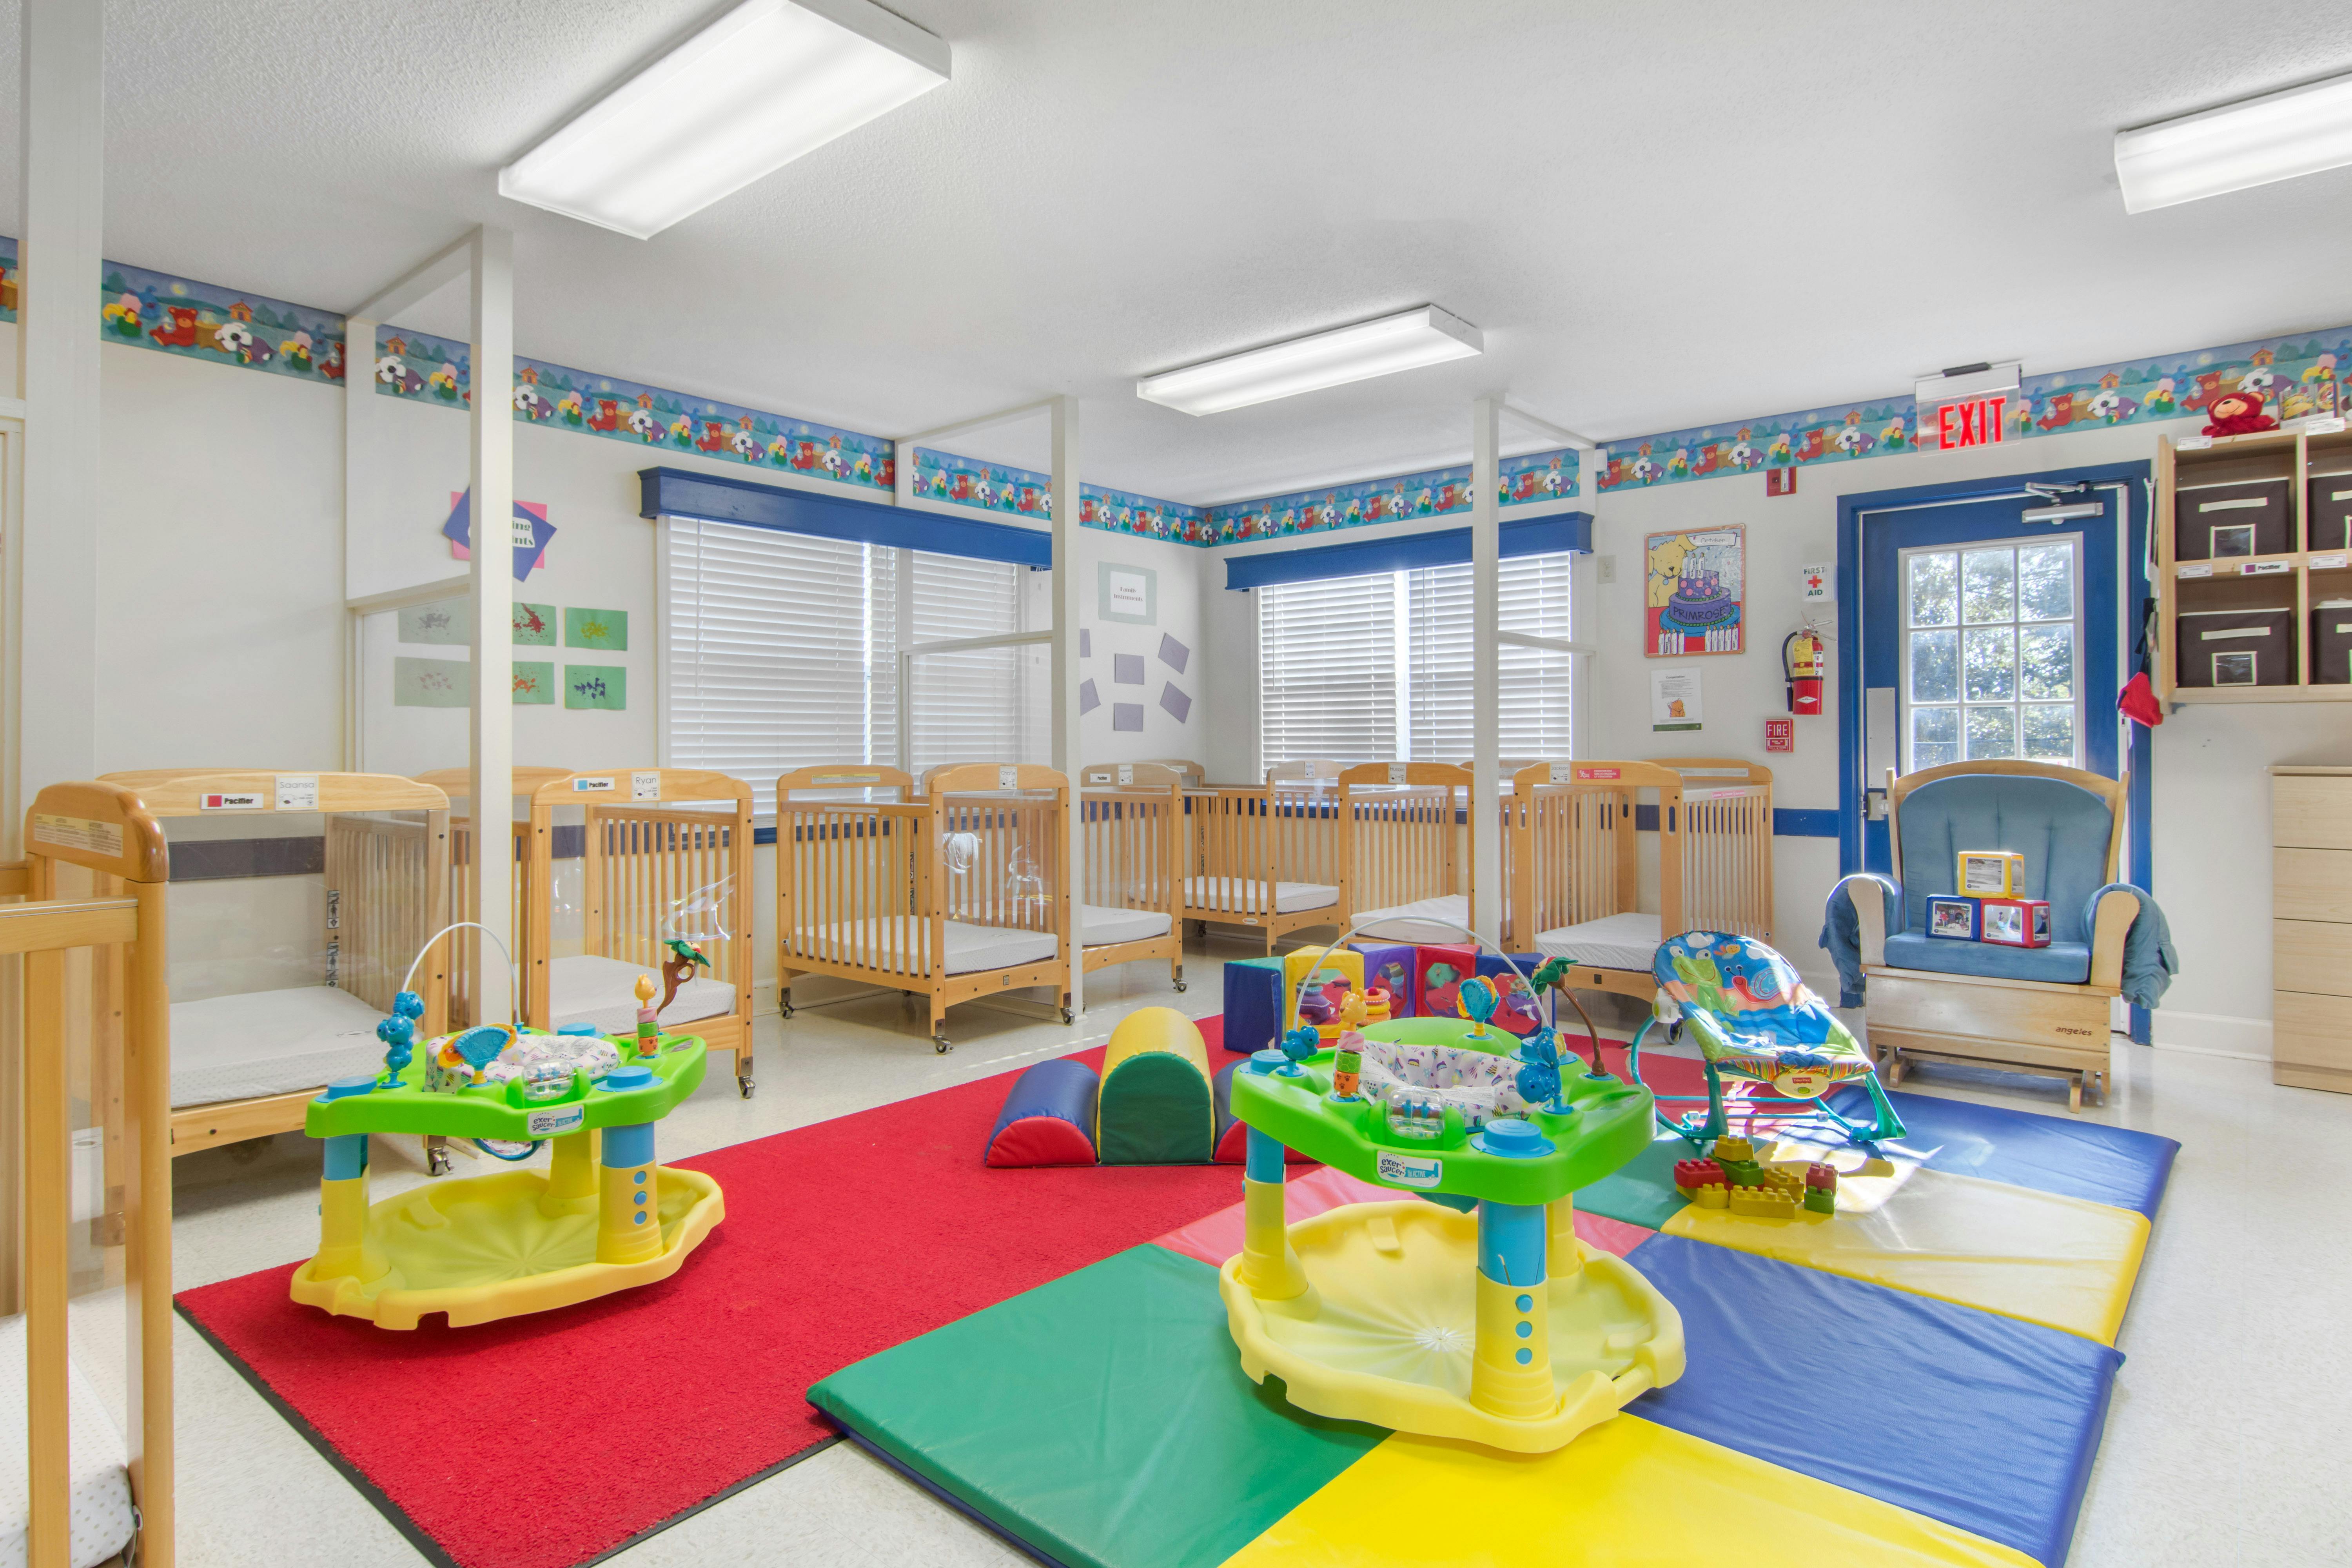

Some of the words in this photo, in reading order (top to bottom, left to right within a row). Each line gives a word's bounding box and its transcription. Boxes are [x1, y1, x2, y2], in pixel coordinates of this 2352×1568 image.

[1938, 396, 2007, 450] EXIT
[1673, 605, 1726, 621] PRIMROSE
[1768, 724, 1788, 736] FIRE
[636, 777, 657, 785] Ryan
[2055, 1027, 2092, 1036] angeles
[532, 1123, 555, 1131] saucer
[1381, 1158, 1401, 1168] exer
[1380, 1166, 1405, 1175] saucer
